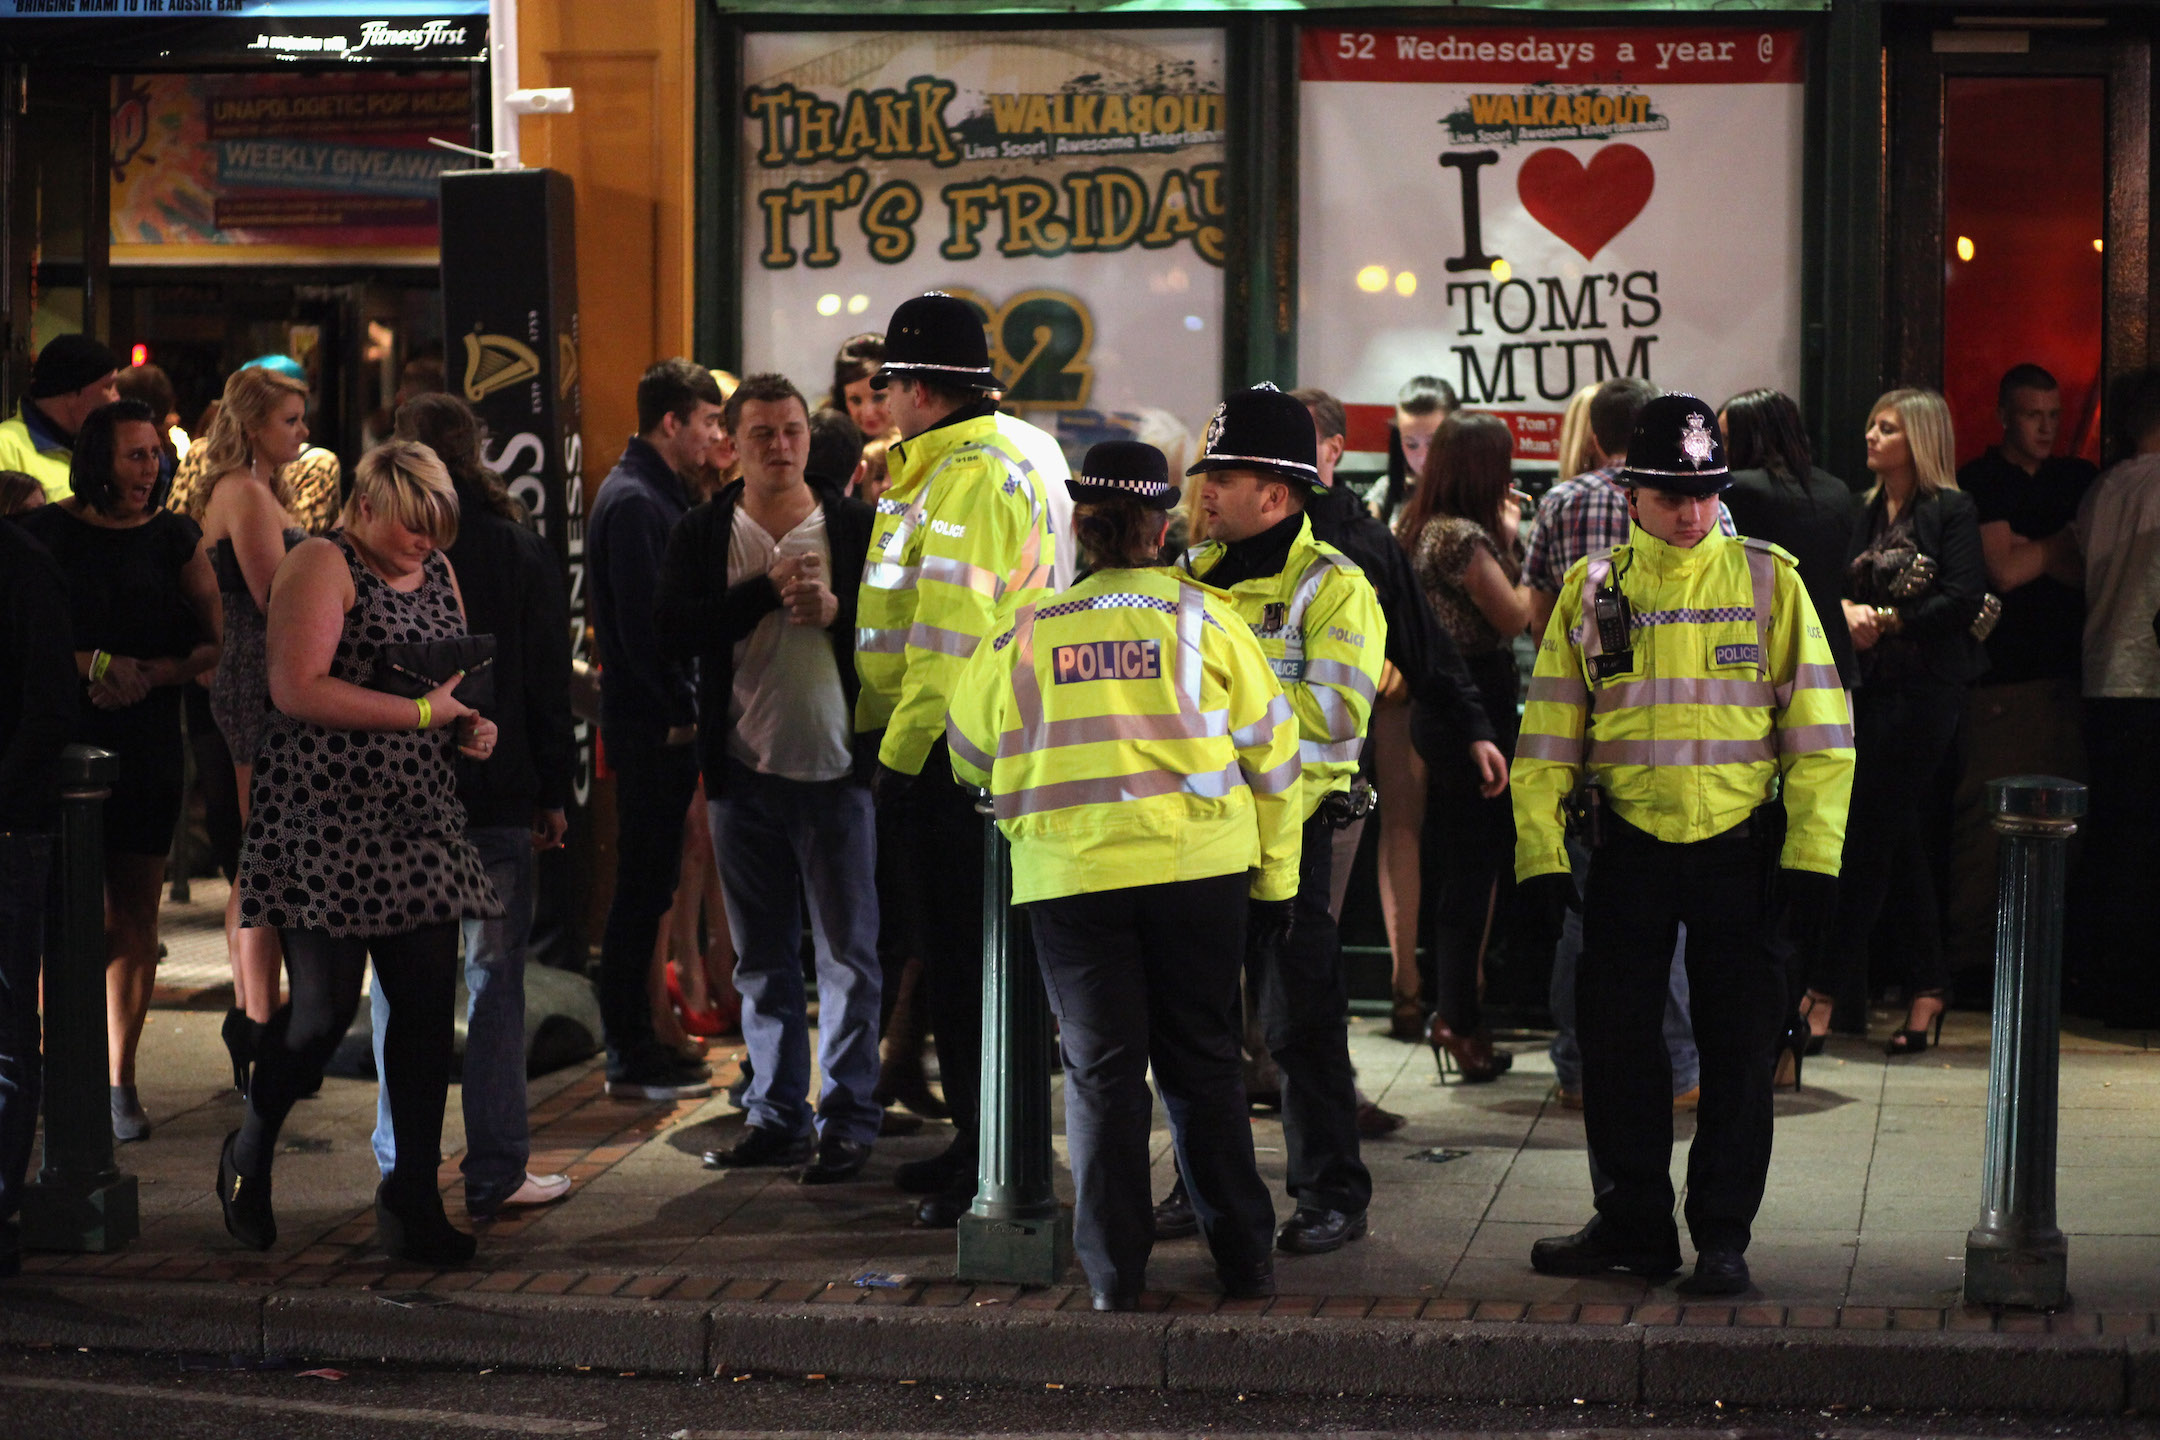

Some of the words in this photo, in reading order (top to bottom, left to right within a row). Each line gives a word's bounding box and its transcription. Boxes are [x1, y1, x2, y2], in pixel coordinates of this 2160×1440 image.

[79, 0, 118, 12] MIAMI
[123, 0, 138, 12] TO
[143, 0, 164, 12] THE
[168, 0, 213, 11] AUSSIE
[1338, 33, 1376, 60] 52
[1396, 35, 1595, 70] Wednesdays
[1616, 40, 1635, 62] a
[1655, 38, 1736, 70] year
[1757, 35, 1774, 63] @
[746, 76, 957, 166] THANK
[988, 92, 1225, 135] WALKABOUT
[1470, 93, 1651, 126] WALKABOUT
[964, 143, 998, 160] Live
[1001, 140, 1047, 158] Sport
[1056, 135, 1136, 154] Awesome
[1518, 126, 1578, 140] Awesome
[226, 142, 331, 174] WEEKLY
[761, 162, 923, 268] IT'S
[1439, 149, 1503, 272] I
[1446, 270, 1662, 336] TOM'S
[1449, 334, 1659, 405] MUM
[1516, 416, 1557, 431] Tom?
[955, 454, 980, 464] 9186
[930, 518, 967, 539] POLICE
[1328, 625, 1366, 648] POLICE
[1057, 641, 1157, 683] POLICE
[1716, 644, 1758, 663] POLICE
